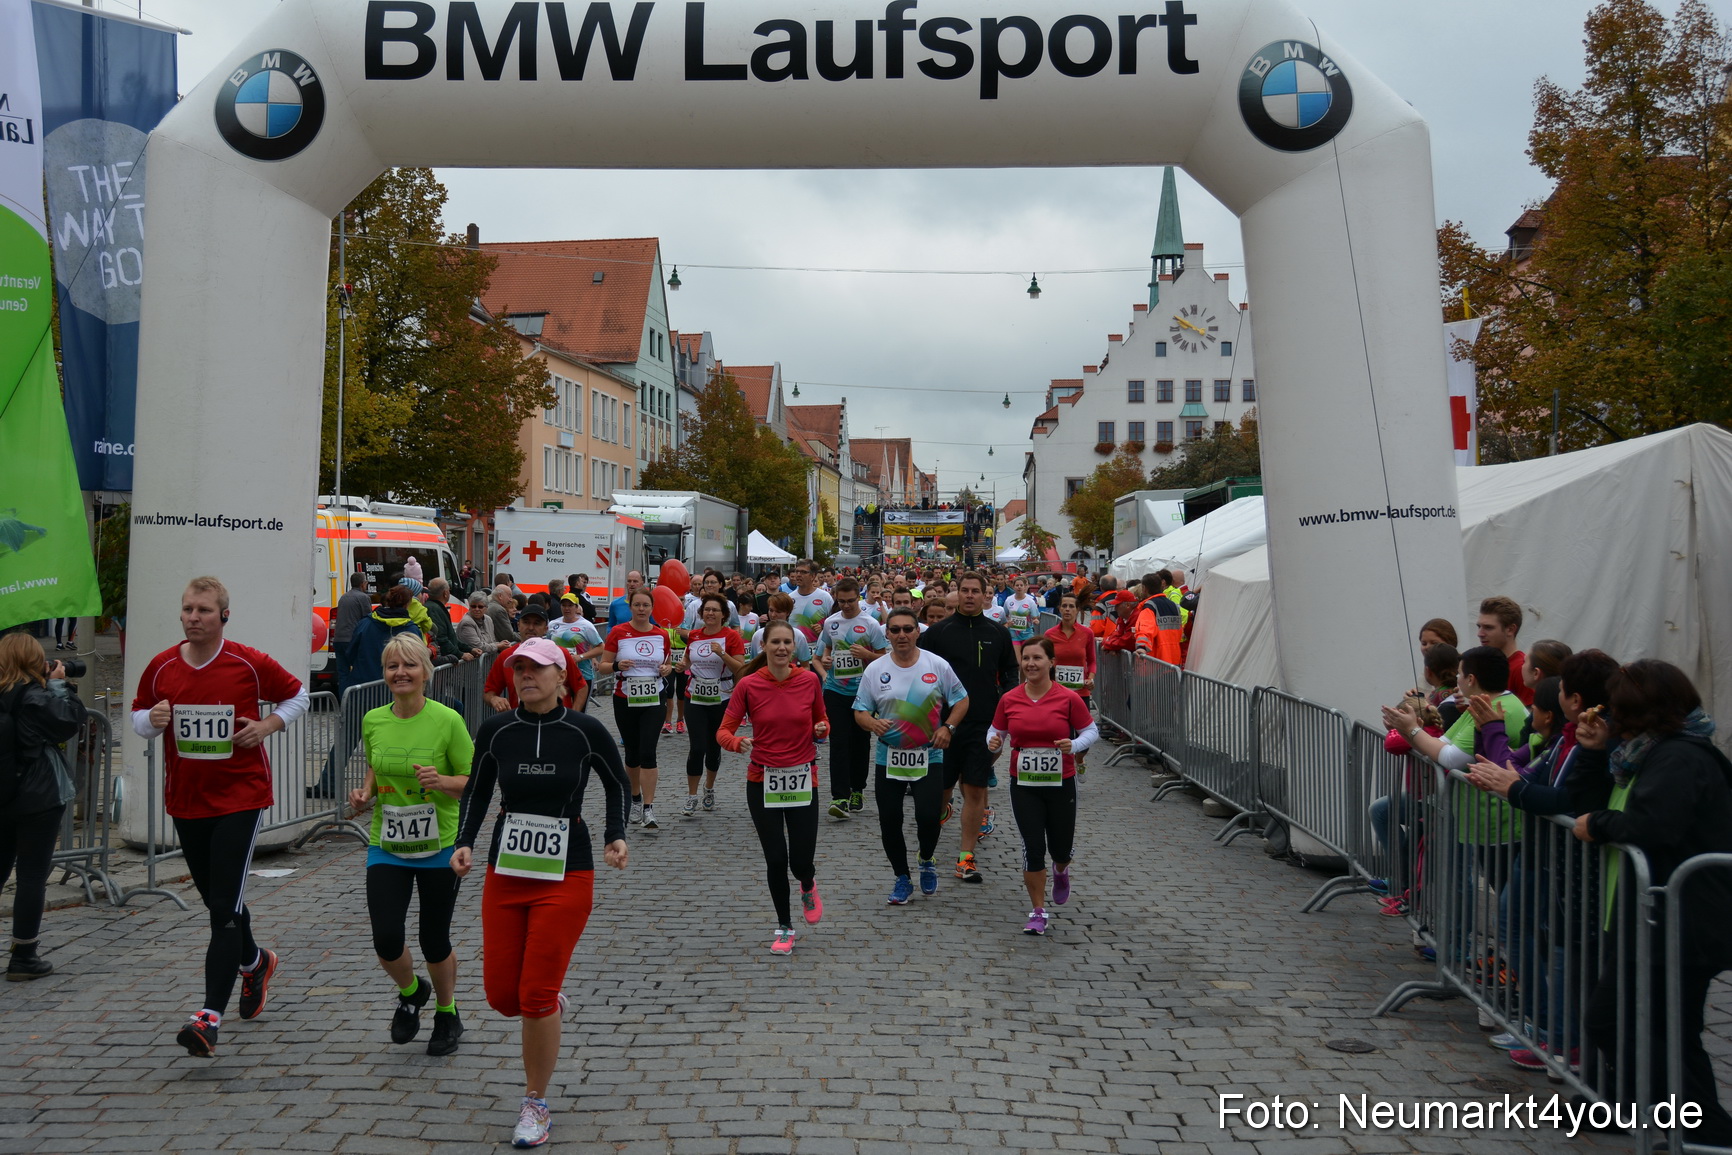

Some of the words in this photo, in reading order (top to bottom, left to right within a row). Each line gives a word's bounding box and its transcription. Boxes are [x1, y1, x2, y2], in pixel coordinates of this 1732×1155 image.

[364, 0, 656, 82] BMW
[684, 0, 1200, 100] Laufsport
[1248, 42, 1340, 79] BMW
[229, 52, 317, 87] BMW
[67, 161, 141, 203] THE
[57, 207, 117, 251] WAY
[99, 247, 142, 290] GO
[134, 512, 283, 531] www.bmw-laufsport.de
[1299, 504, 1456, 526] www.bmw-laufsport.de
[908, 526, 937, 534] START
[836, 657, 860, 669] 5156
[1058, 671, 1082, 682] 5157
[630, 683, 657, 696] 5135
[694, 684, 719, 696] 5039
[180, 718, 229, 739] 5110
[191, 743, 217, 753] Jürgen
[891, 751, 925, 766] 5004
[1022, 756, 1059, 772] 5152
[517, 763, 556, 774] R&D
[769, 774, 807, 791] 5137
[383, 809, 397, 817] PARTL
[387, 817, 431, 839] 5147
[525, 821, 557, 830] Neumarkt
[391, 843, 429, 852] Walburga
[507, 828, 562, 856] 5003
